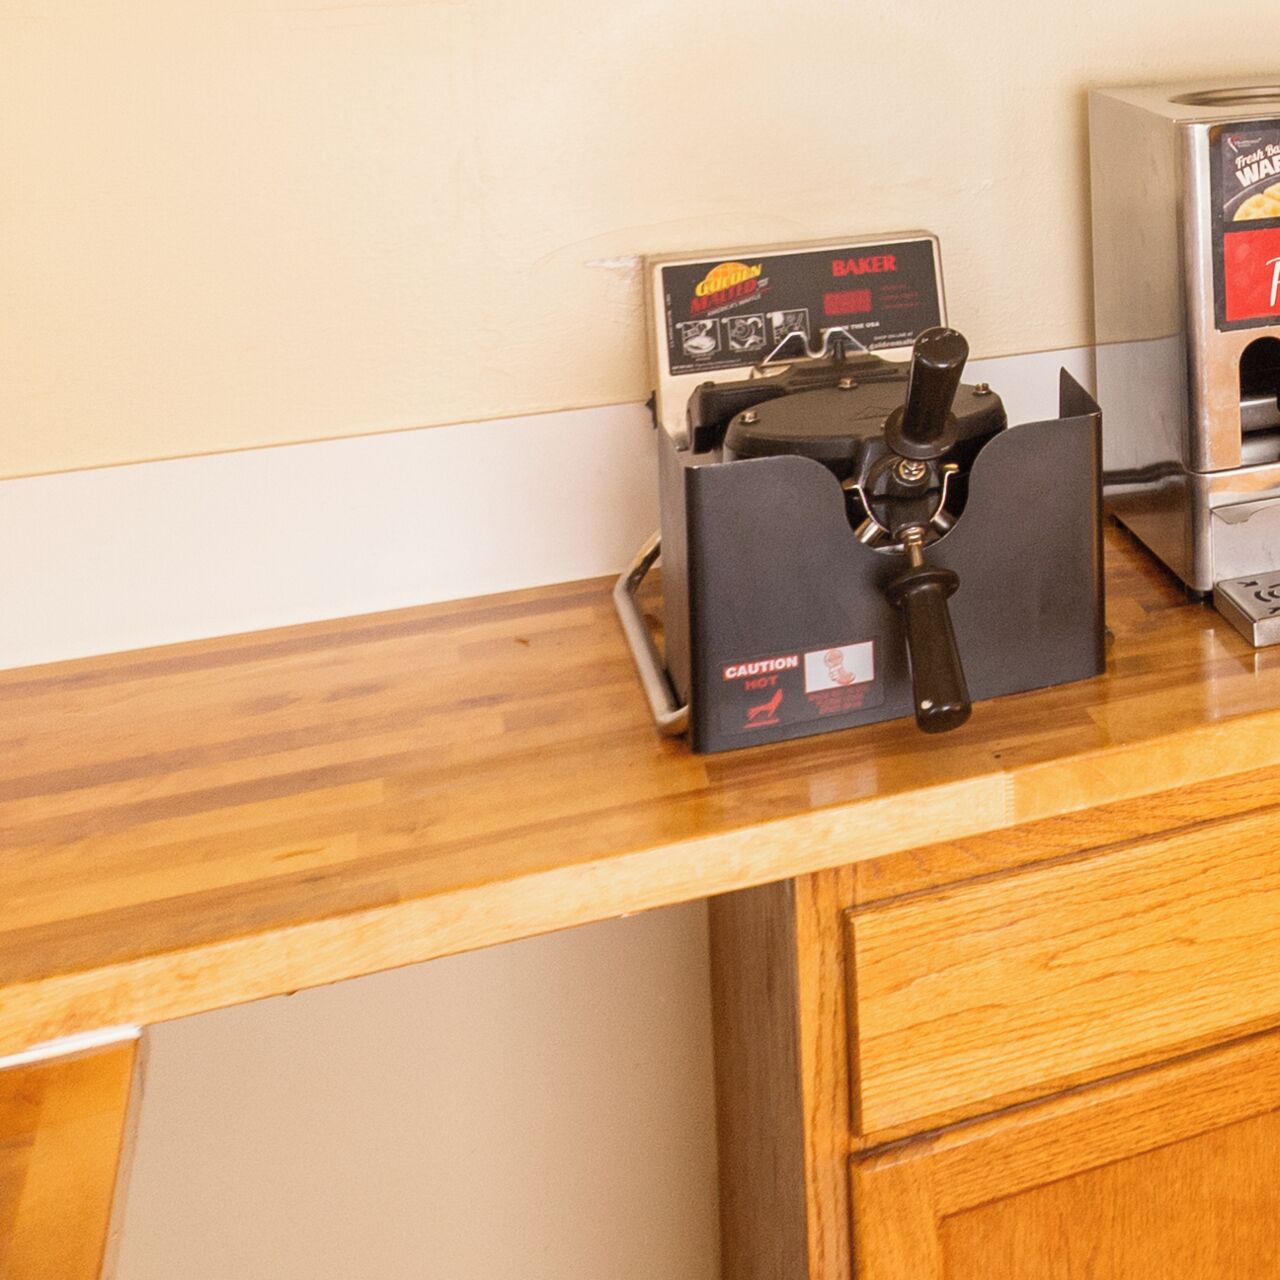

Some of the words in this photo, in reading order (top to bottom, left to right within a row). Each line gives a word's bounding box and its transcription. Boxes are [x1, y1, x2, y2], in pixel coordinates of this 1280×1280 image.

[1235, 149, 1265, 169] Fresh
[831, 254, 897, 277] BAKER
[724, 655, 799, 679] CAUTION
[744, 675, 778, 691] HOT
